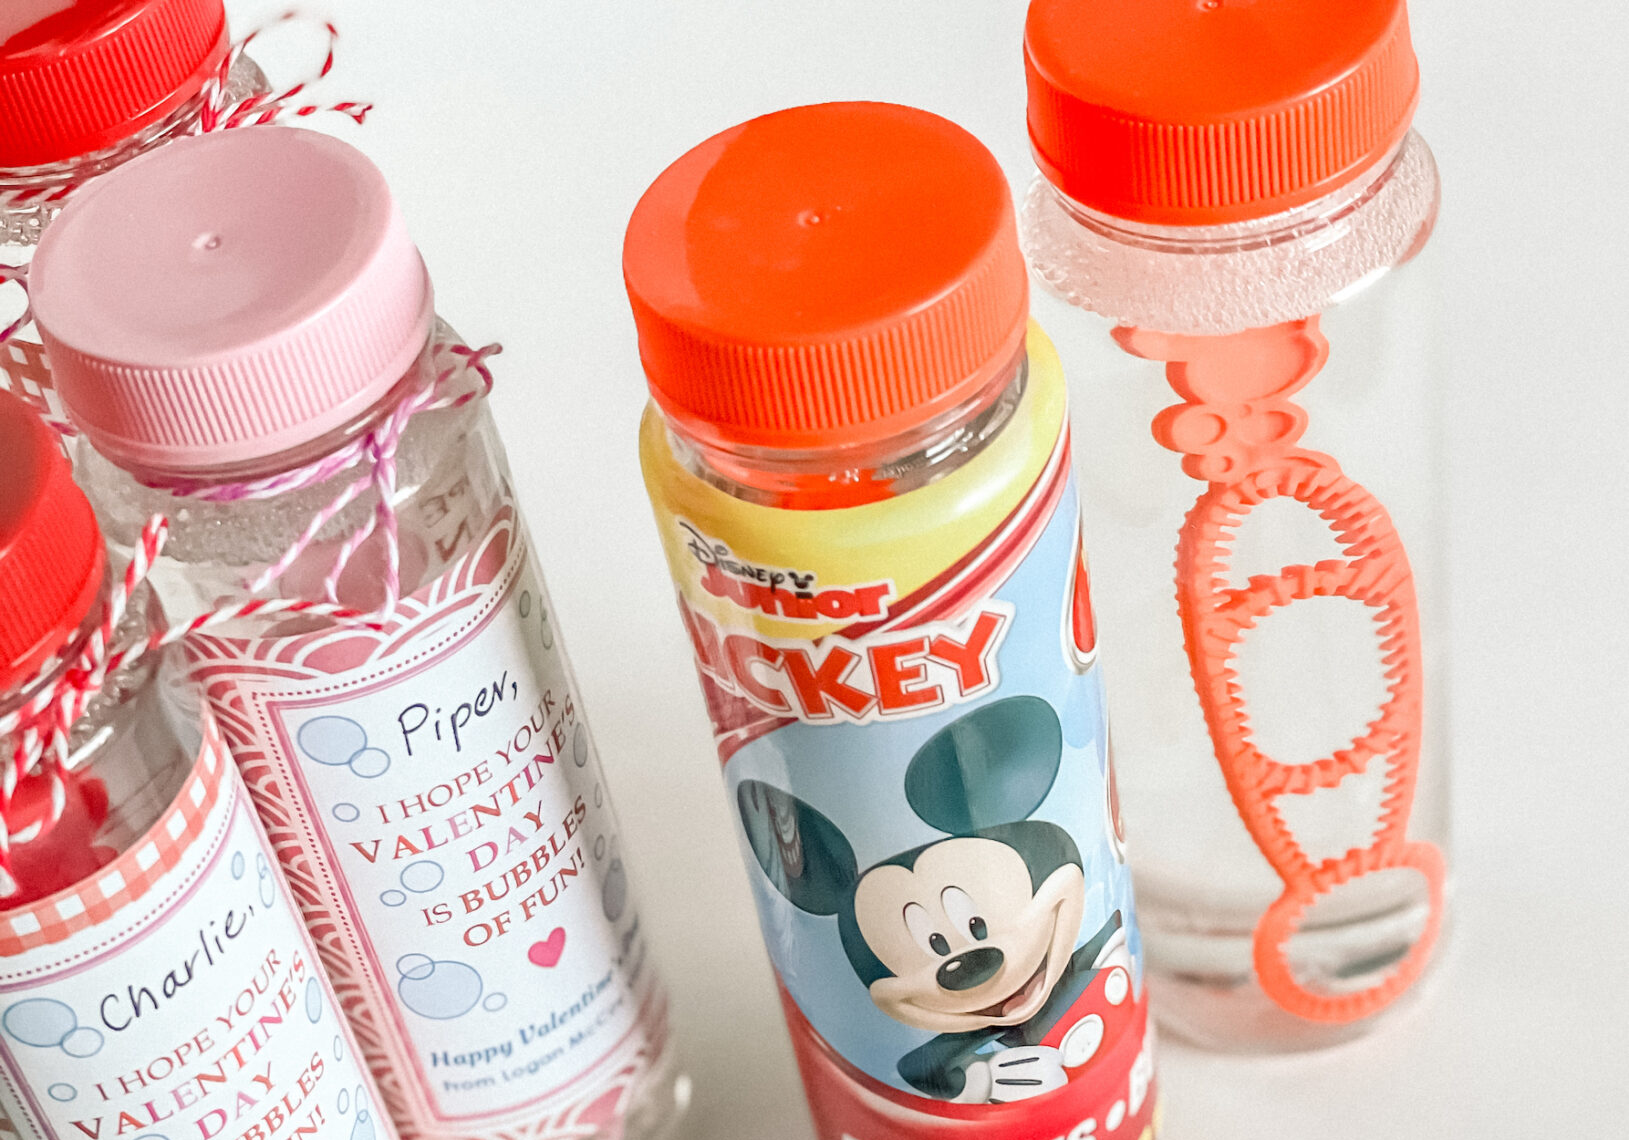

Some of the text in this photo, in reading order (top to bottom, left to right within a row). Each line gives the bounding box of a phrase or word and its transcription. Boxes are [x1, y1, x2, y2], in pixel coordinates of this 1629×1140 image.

[376, 689, 556, 824] I HOPE YOUR
[397, 670, 518, 756] Piper,
[348, 693, 576, 864] VALENTINE'S
[465, 800, 545, 873] DAY
[420, 795, 587, 927] IS BUBBLES
[463, 847, 585, 947] OF FUN!
[95, 948, 281, 1101] I HOPE YOUR
[100, 904, 255, 1032] Charlie,
[70, 949, 306, 1140] VALENTINE'S
[430, 1041, 513, 1068] Happy
